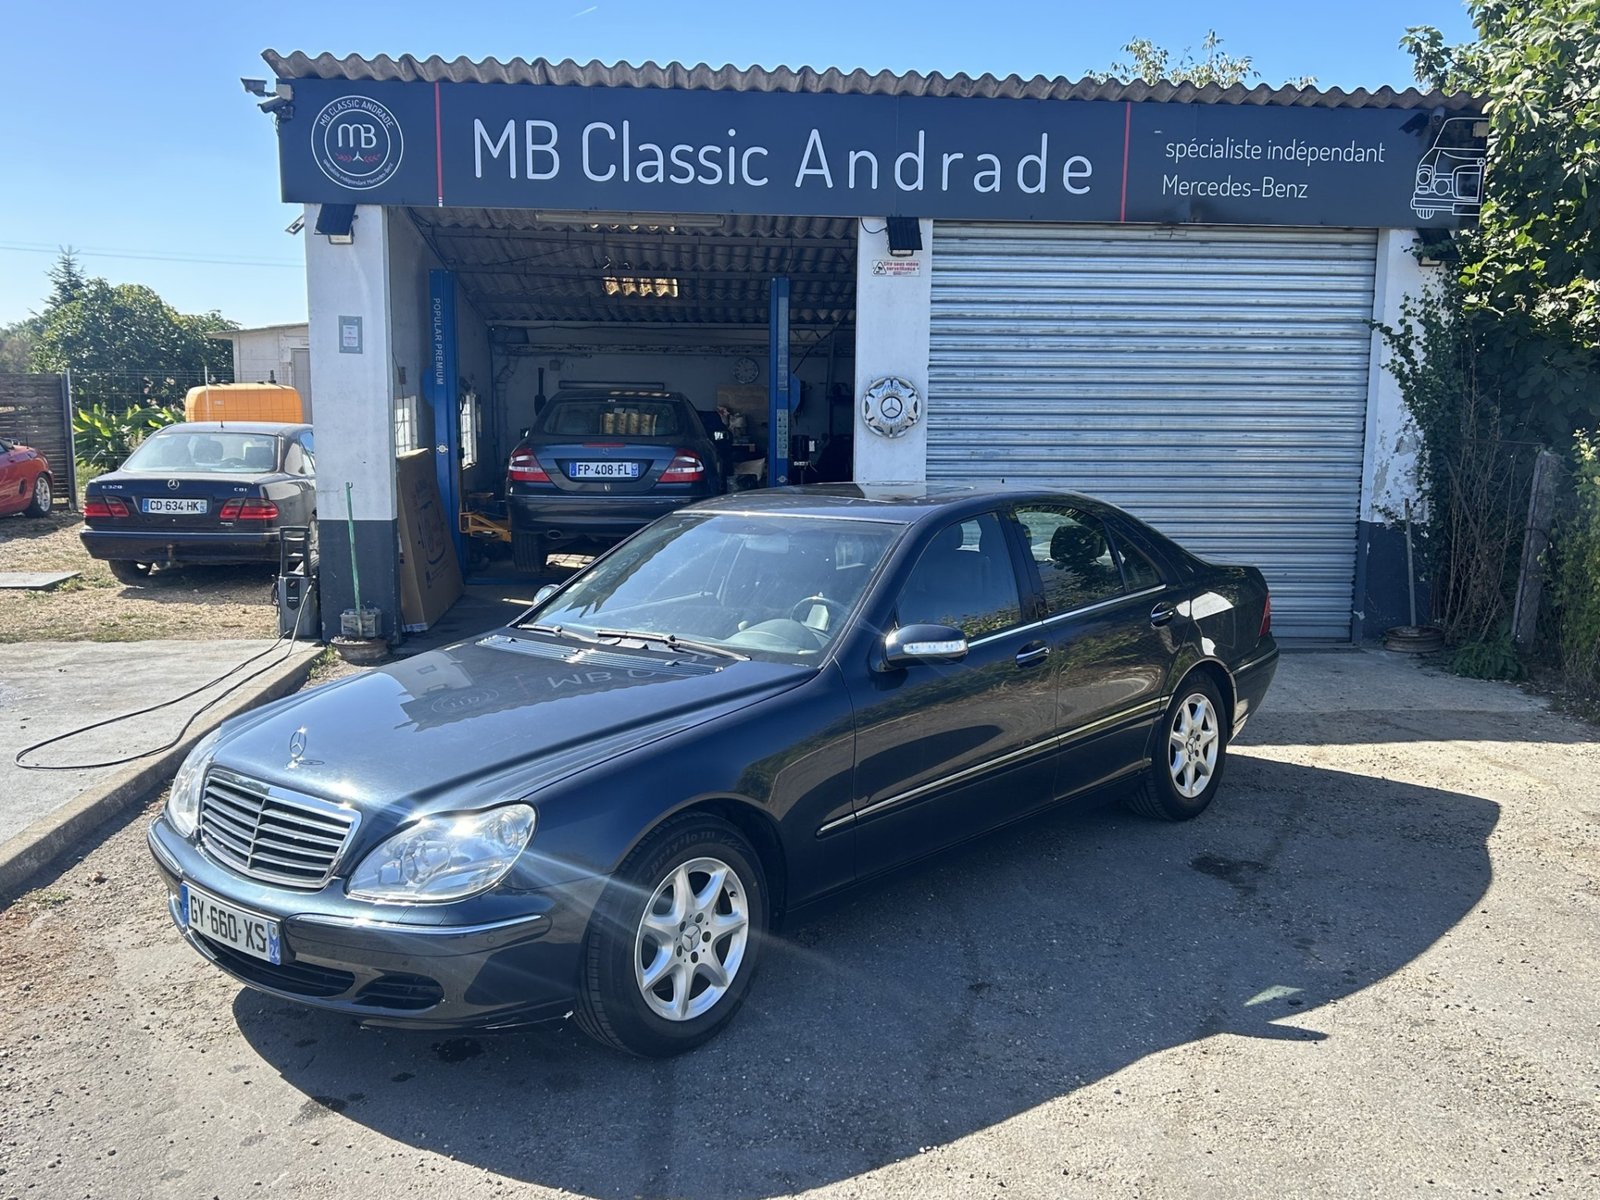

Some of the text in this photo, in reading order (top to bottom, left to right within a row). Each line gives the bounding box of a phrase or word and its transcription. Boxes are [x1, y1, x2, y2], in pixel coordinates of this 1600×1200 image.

[320, 99, 394, 129] MB CLASSIC ANDRADE
[474, 118, 1092, 195] MB Classic Andrade
[1165, 137, 1385, 167] spécialiste indépendant
[1162, 174, 1309, 199] Mercedes-Benz
[433, 297, 444, 385] POPULAR PREMIUM
[577, 464, 631, 476] FP-408-FL
[190, 894, 267, 953] GY-660-XS
